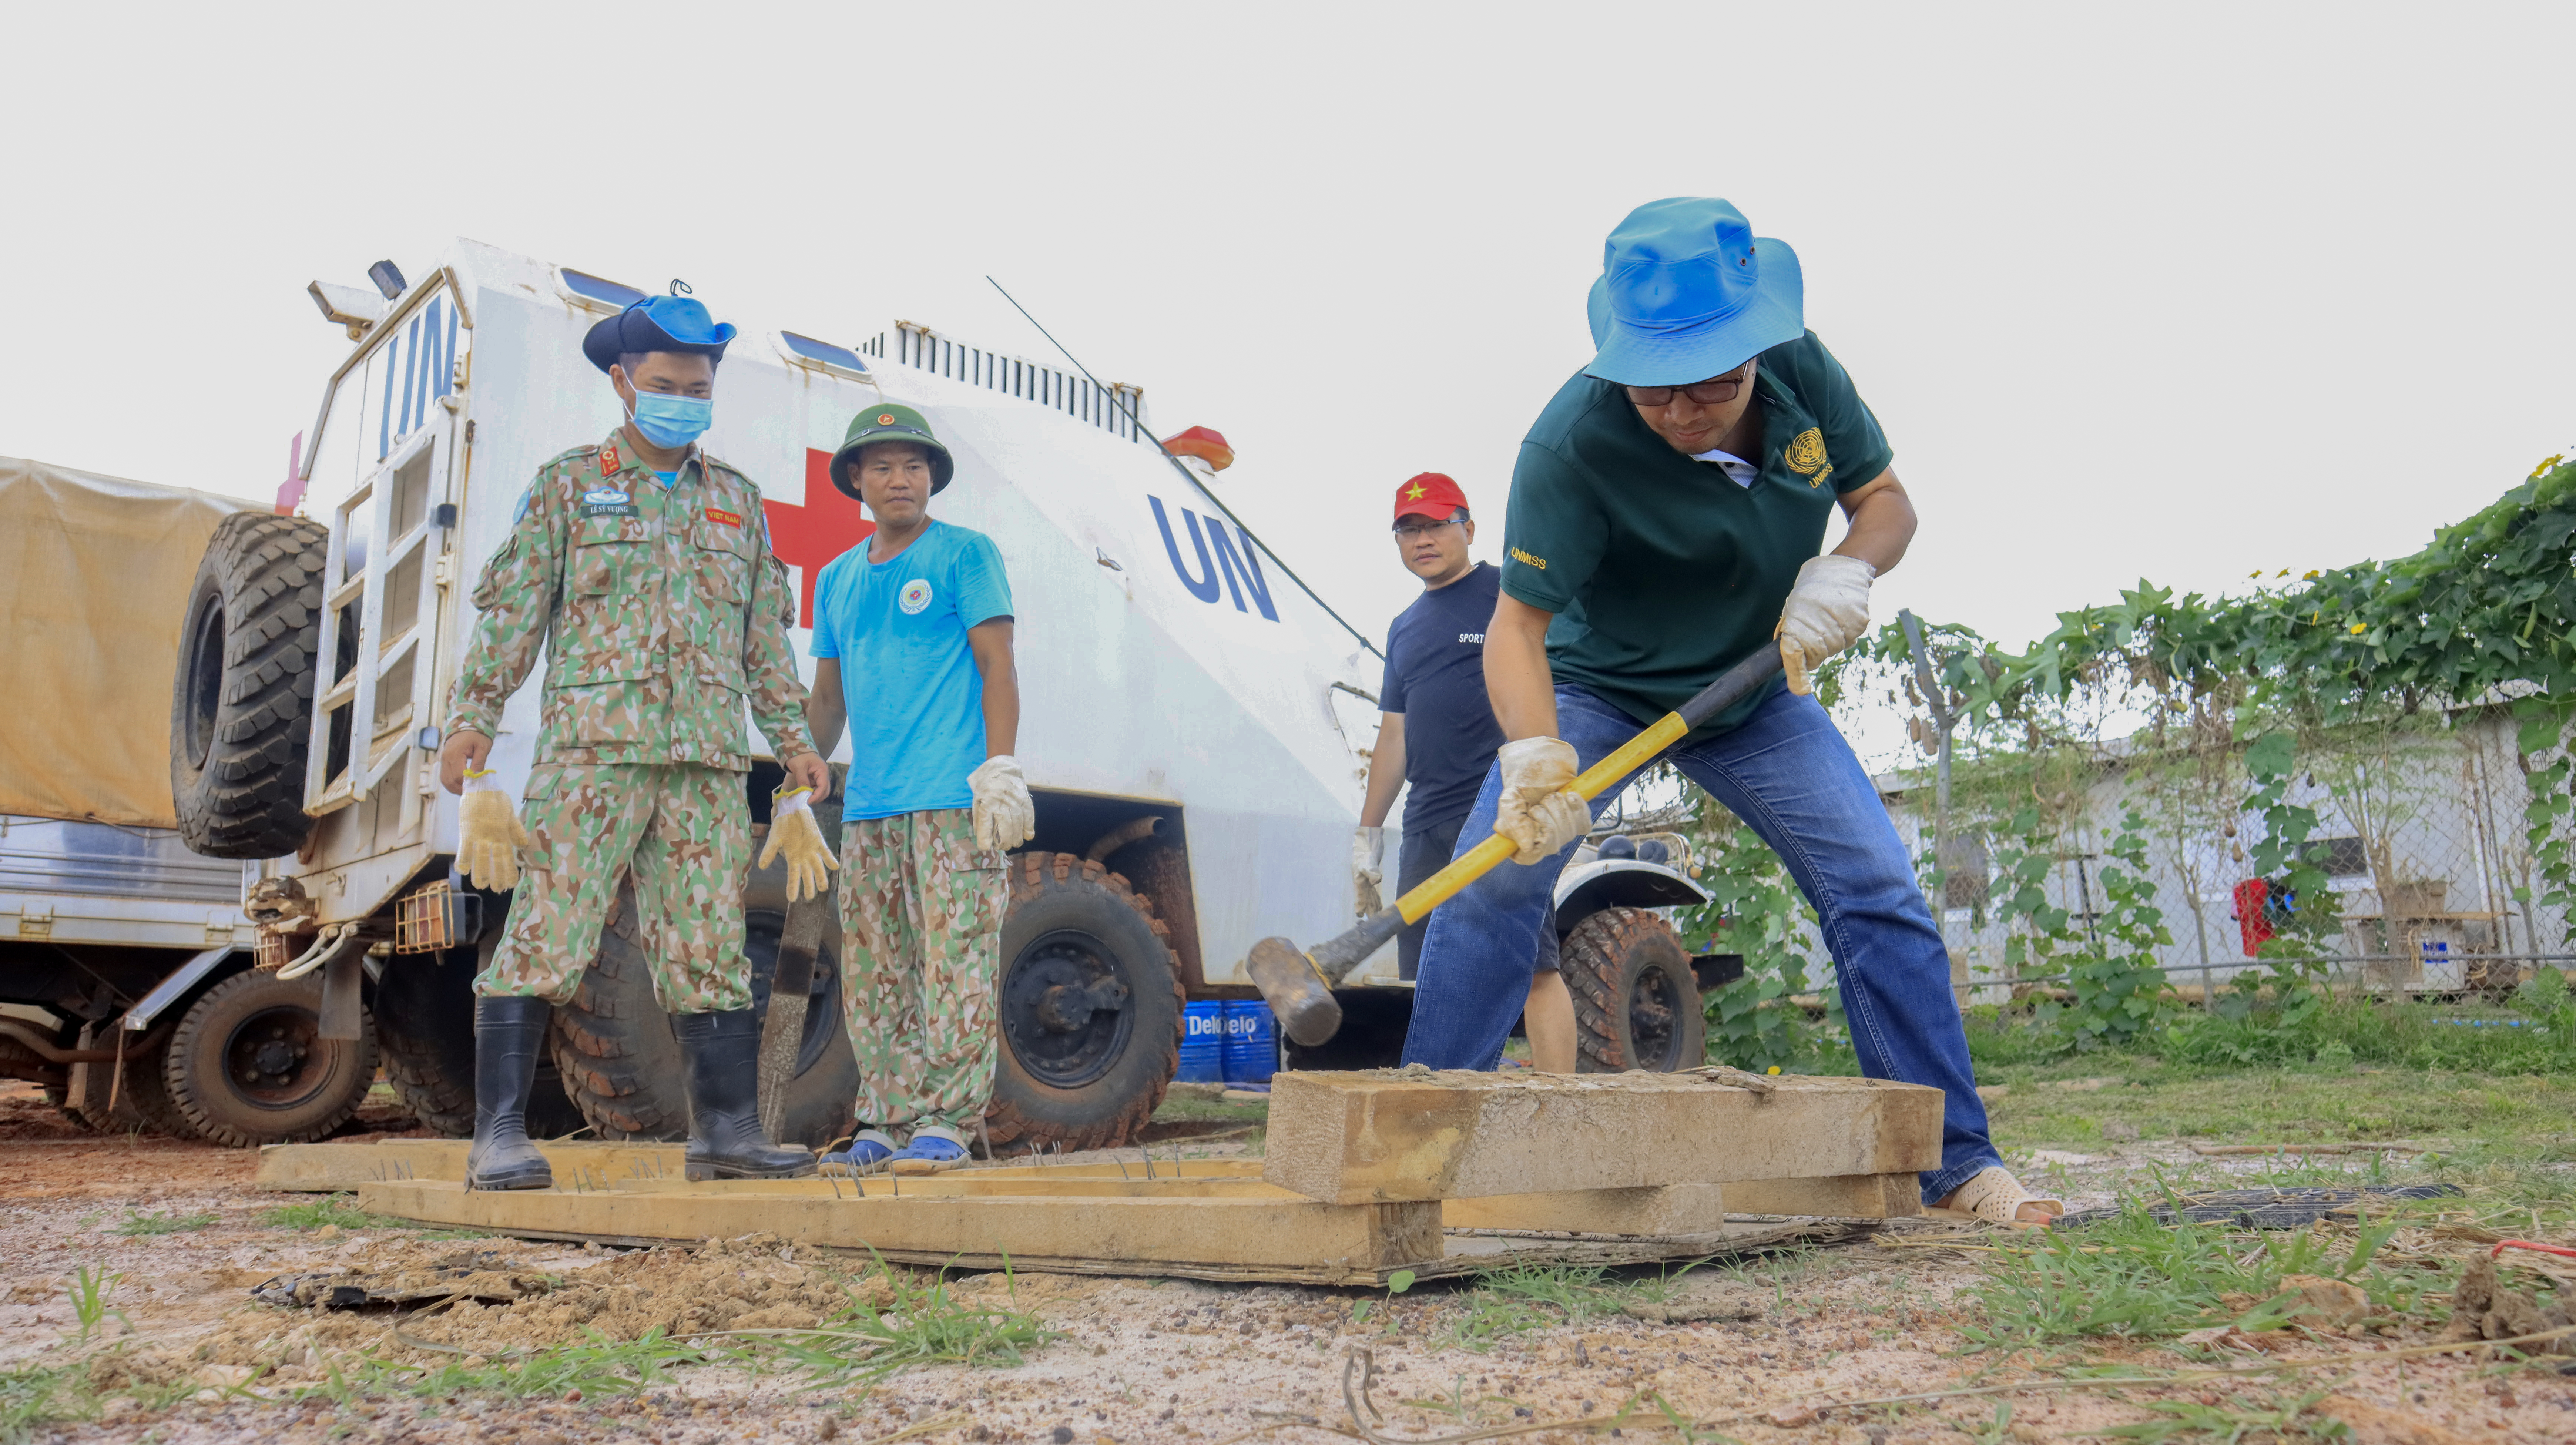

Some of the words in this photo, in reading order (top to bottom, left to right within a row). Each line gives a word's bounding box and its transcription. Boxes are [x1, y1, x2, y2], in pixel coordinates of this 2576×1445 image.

[379, 294, 458, 459] UN
[725, 515, 739, 524] NAM
[1147, 494, 1280, 623] UN
[1511, 546, 1546, 570] UNMISS
[1459, 633, 1485, 644] SPORT
[1188, 1015, 1221, 1036] Delo
